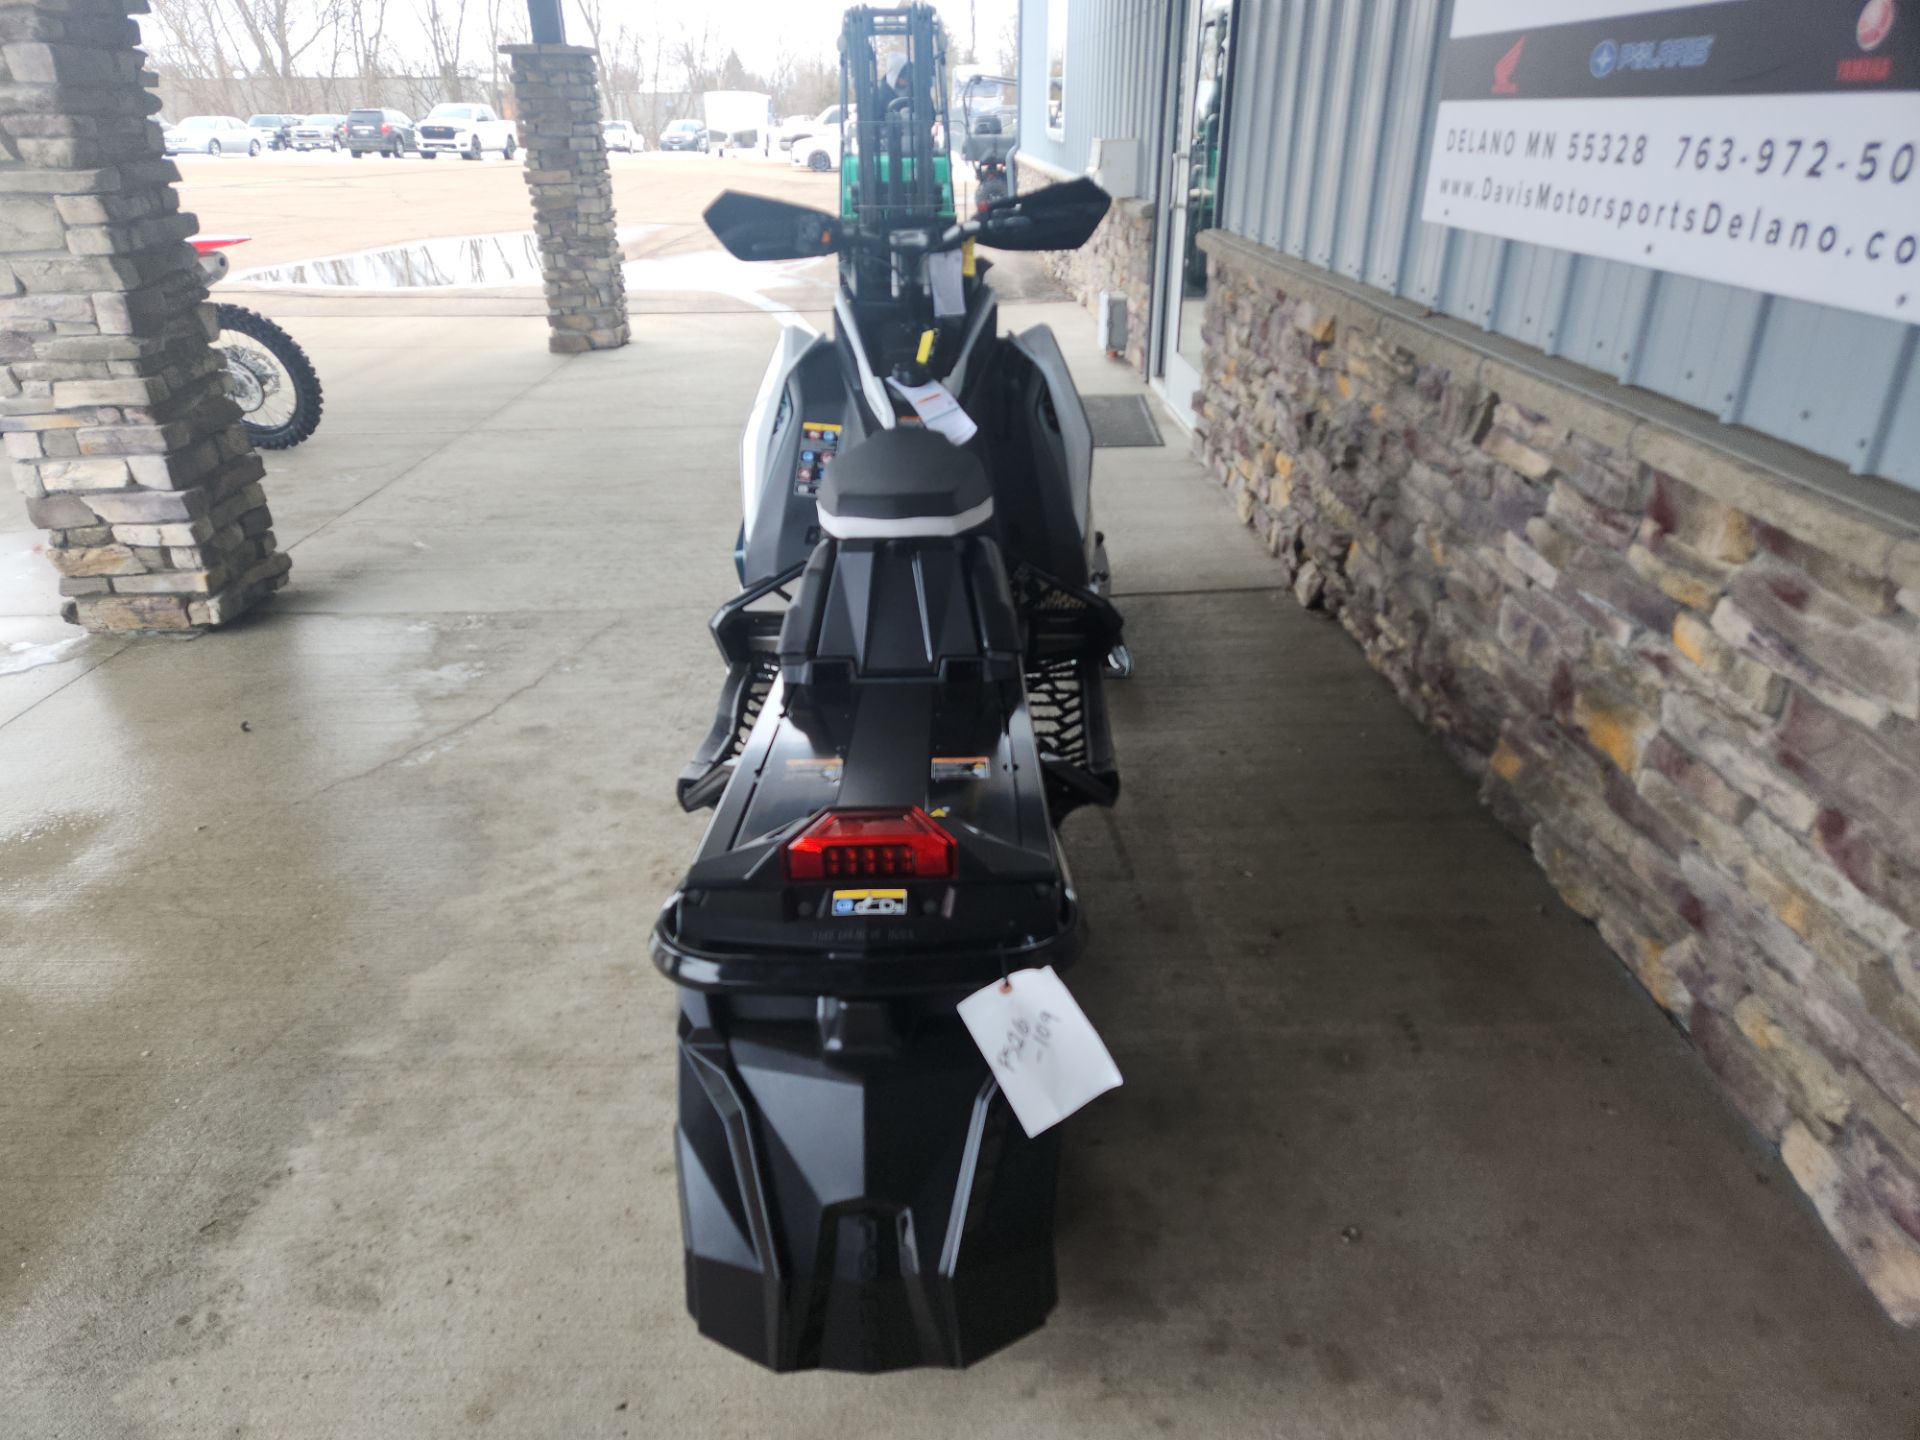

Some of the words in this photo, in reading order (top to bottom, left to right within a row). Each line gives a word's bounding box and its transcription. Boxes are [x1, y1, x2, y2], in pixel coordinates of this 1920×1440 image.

[1446, 129, 1515, 157] DELANO
[1525, 131, 1556, 159] MN
[1567, 133, 1648, 165] 55328
[1675, 136, 1914, 184] 763-972-50
